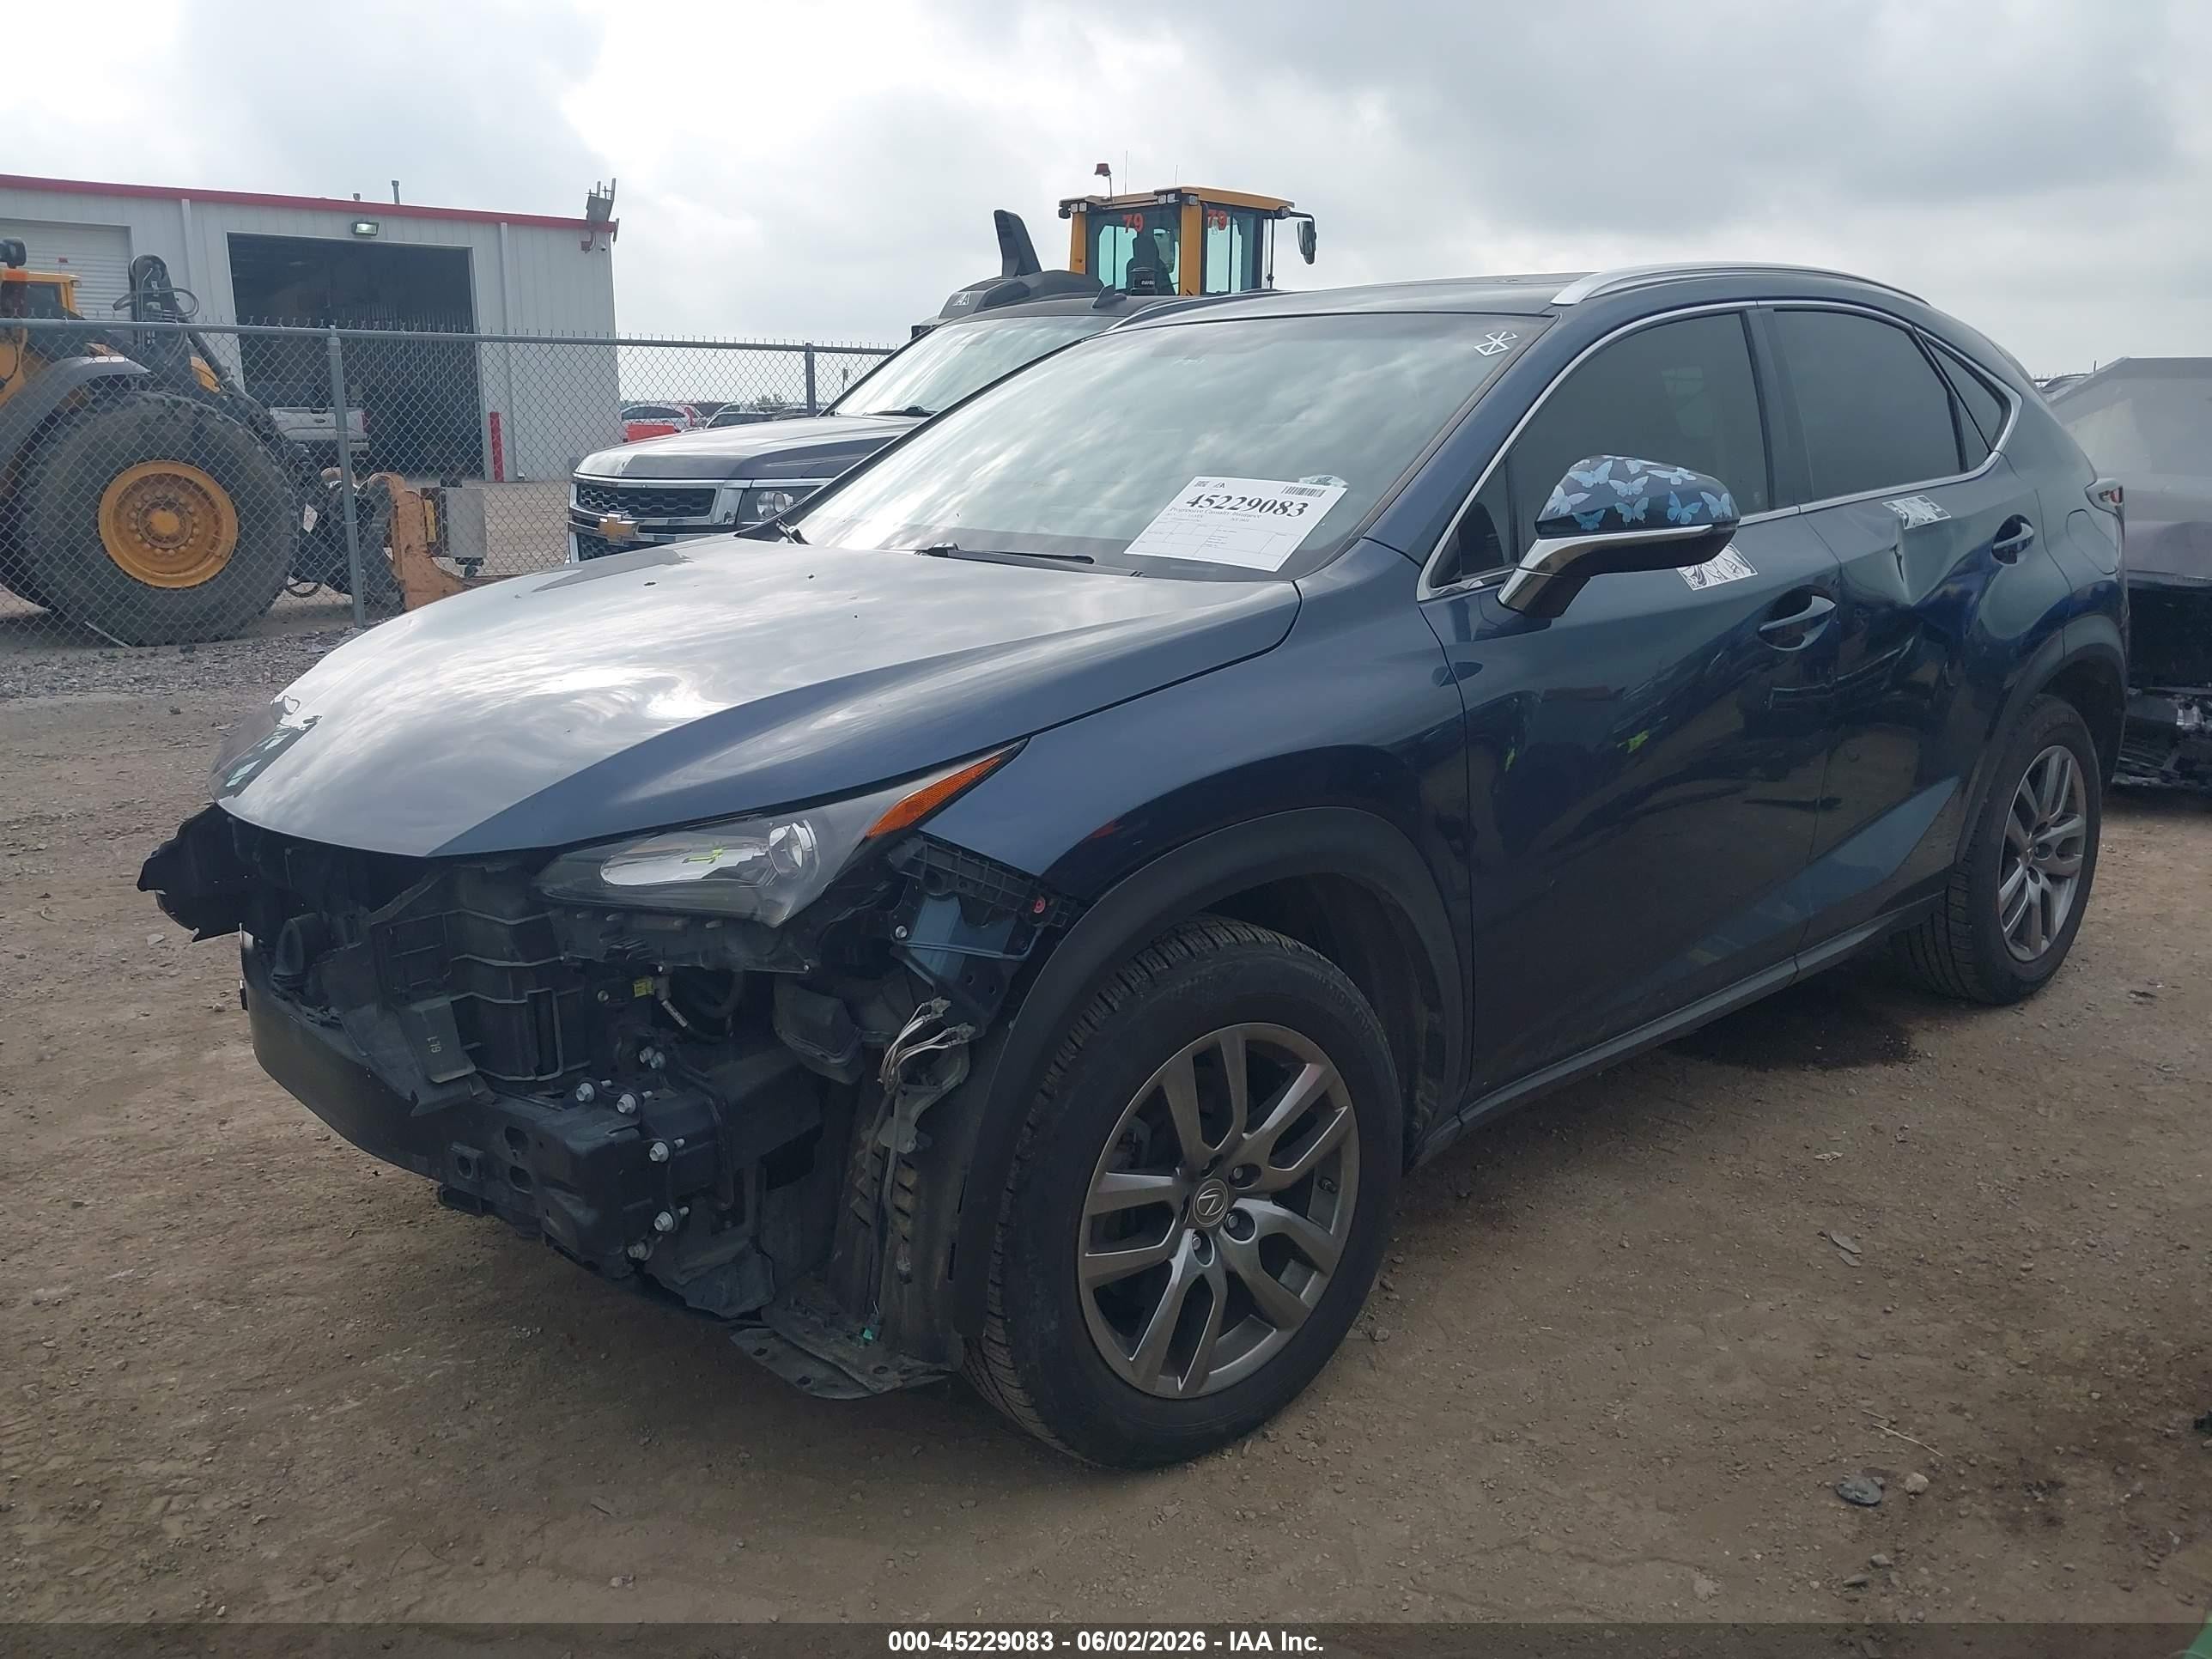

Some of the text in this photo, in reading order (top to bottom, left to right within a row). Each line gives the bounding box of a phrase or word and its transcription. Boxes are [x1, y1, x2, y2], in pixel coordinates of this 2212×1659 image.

[1122, 213, 1144, 234] 79
[1208, 210, 1228, 231] 79
[1186, 494, 1309, 517] 45229083
